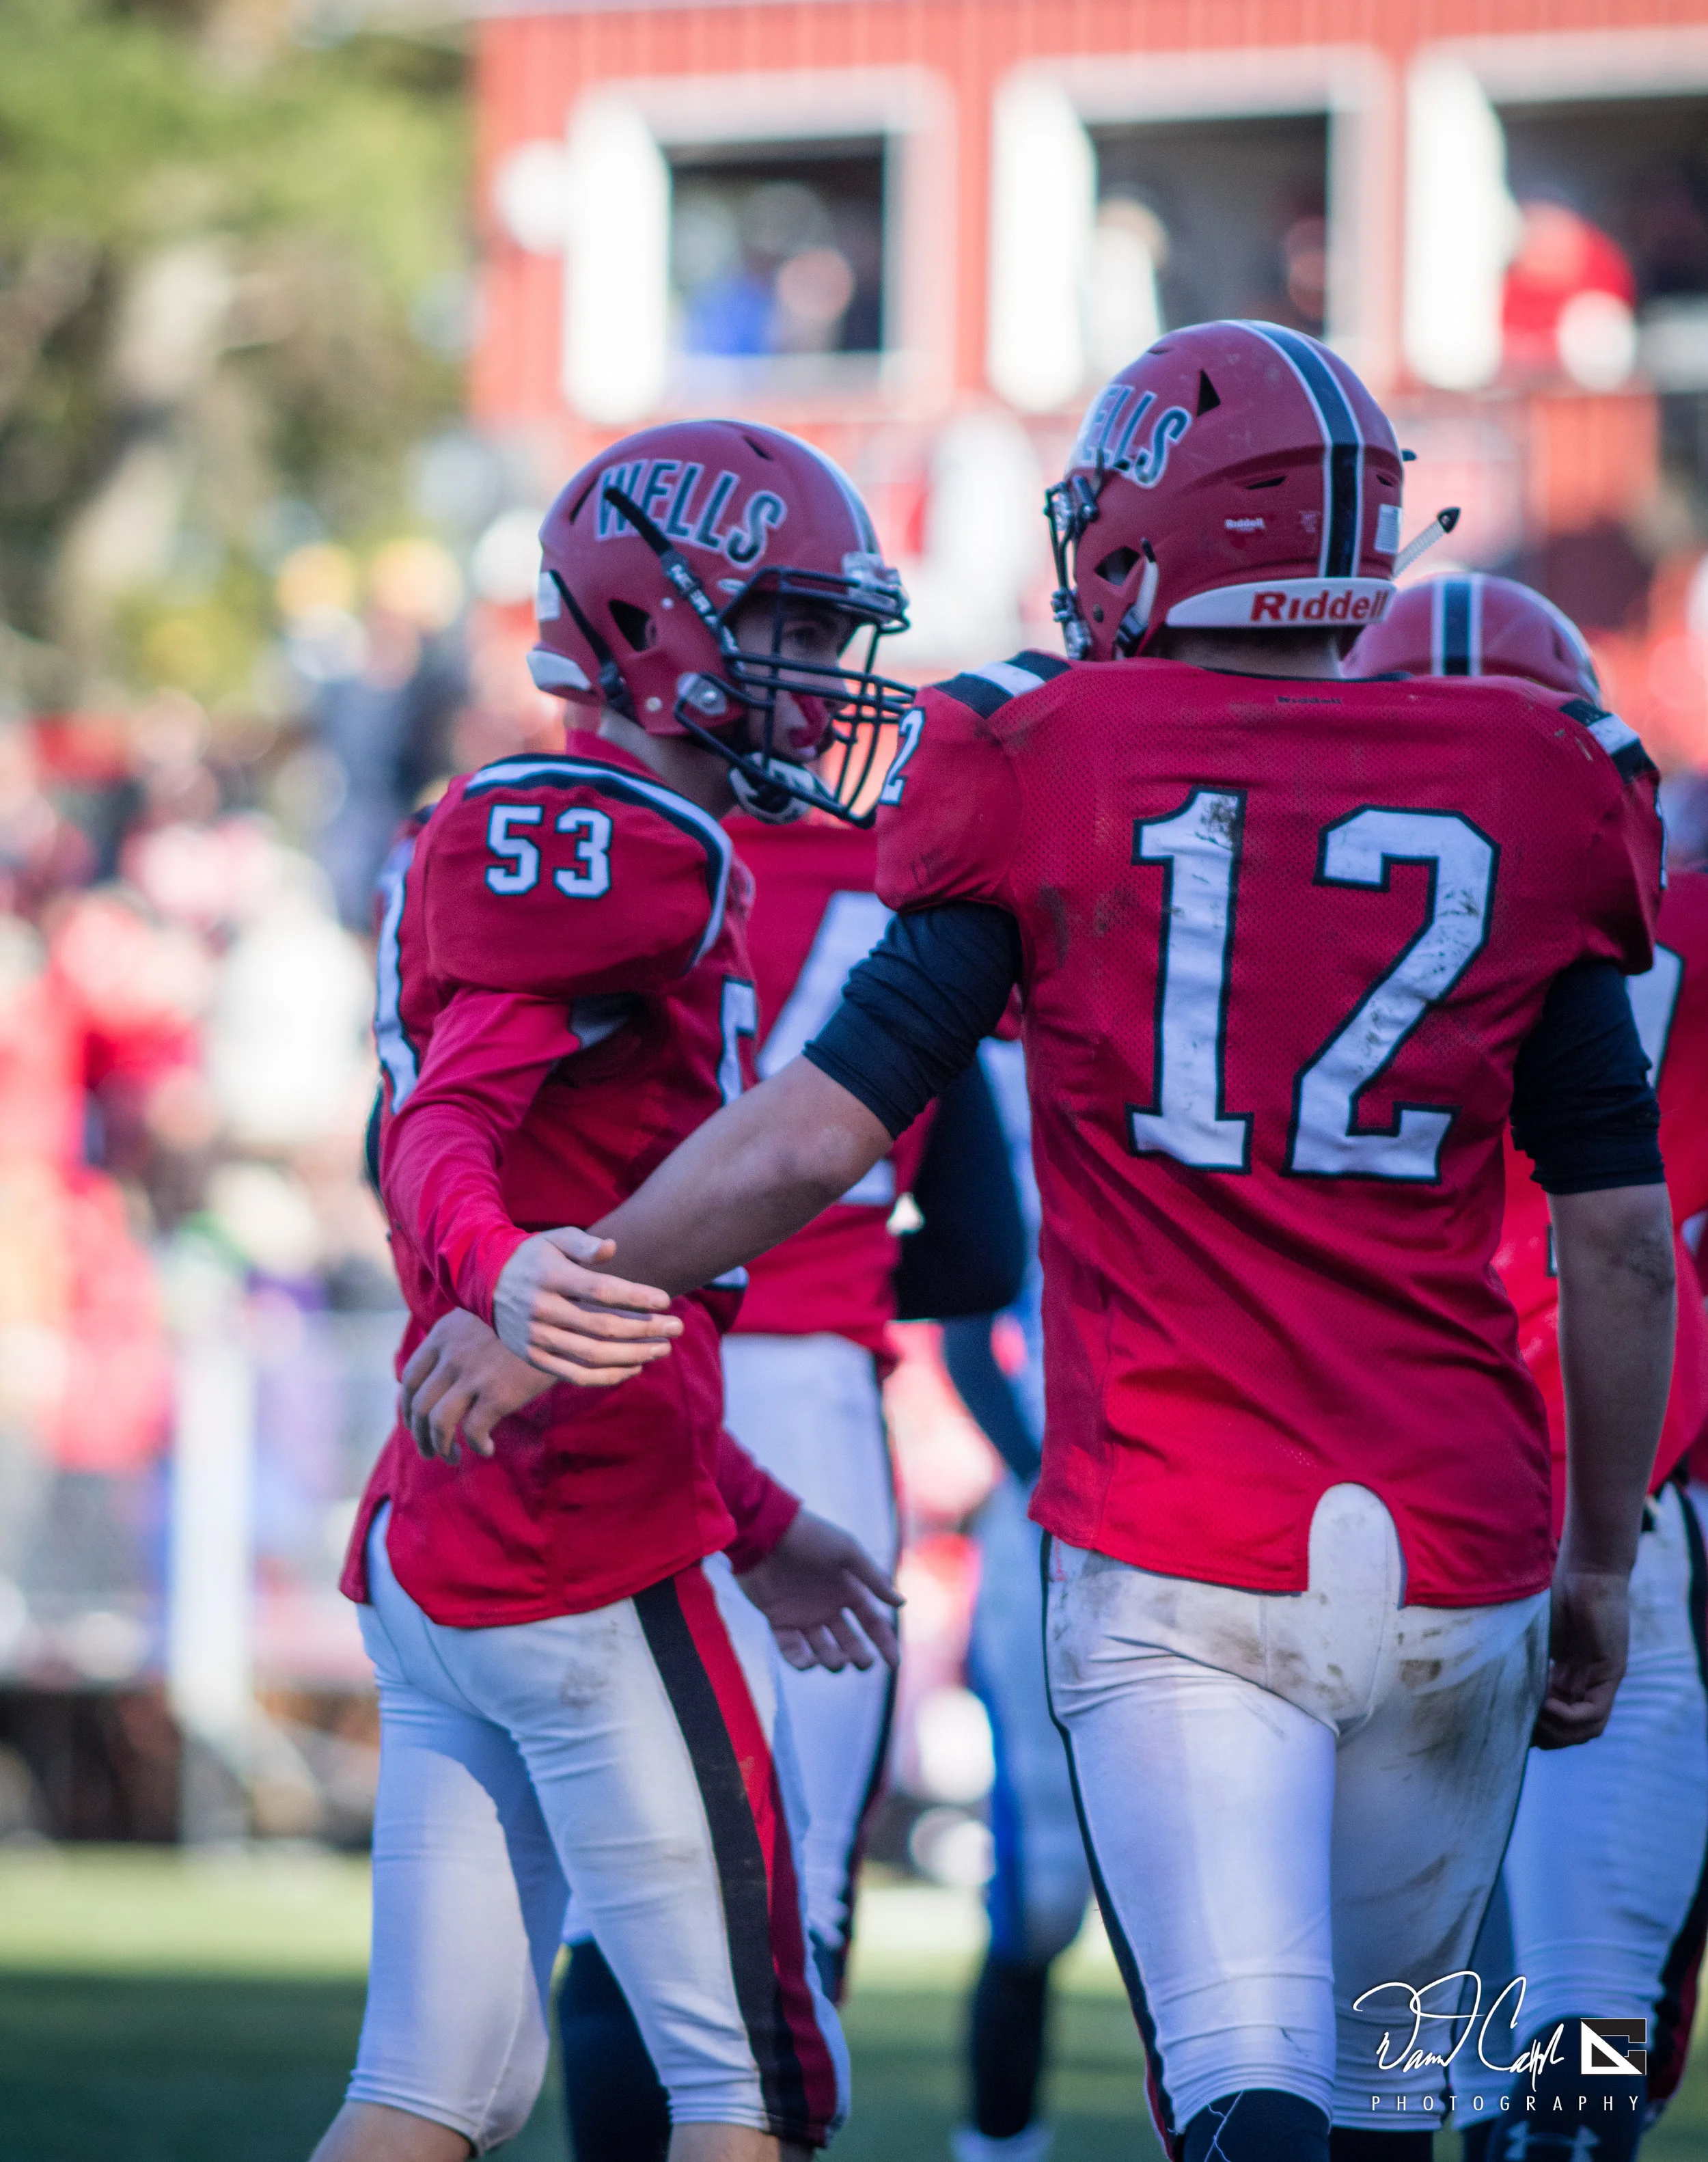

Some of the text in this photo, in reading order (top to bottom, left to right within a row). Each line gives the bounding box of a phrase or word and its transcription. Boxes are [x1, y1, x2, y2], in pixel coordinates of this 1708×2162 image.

[1070, 384, 1192, 489] ELLS
[596, 458, 788, 571] WELLS
[1250, 589, 1390, 622] Riddell
[484, 803, 614, 900] 53
[1124, 784, 1502, 1186] 12
